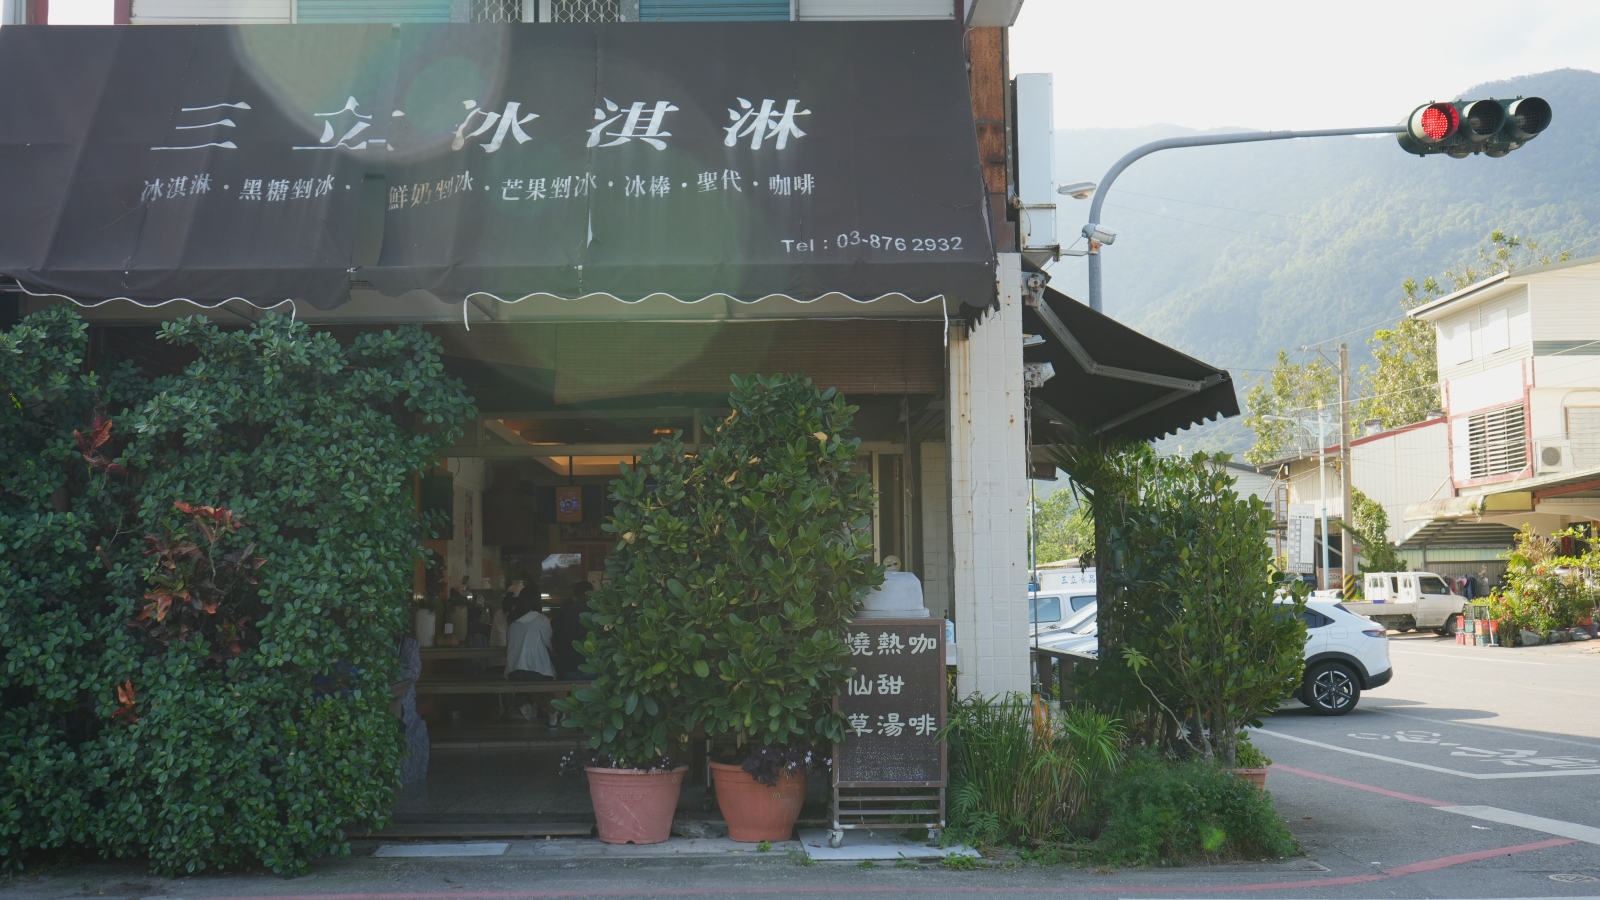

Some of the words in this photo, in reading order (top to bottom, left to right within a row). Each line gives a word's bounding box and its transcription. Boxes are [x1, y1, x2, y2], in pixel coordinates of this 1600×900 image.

[151, 96, 812, 153] 三立冰淇淋
[141, 173, 212, 201] 冰淇淋
[625, 175, 671, 198] 冰棒
[697, 169, 742, 193] 聖代
[769, 174, 815, 195] 咖啡
